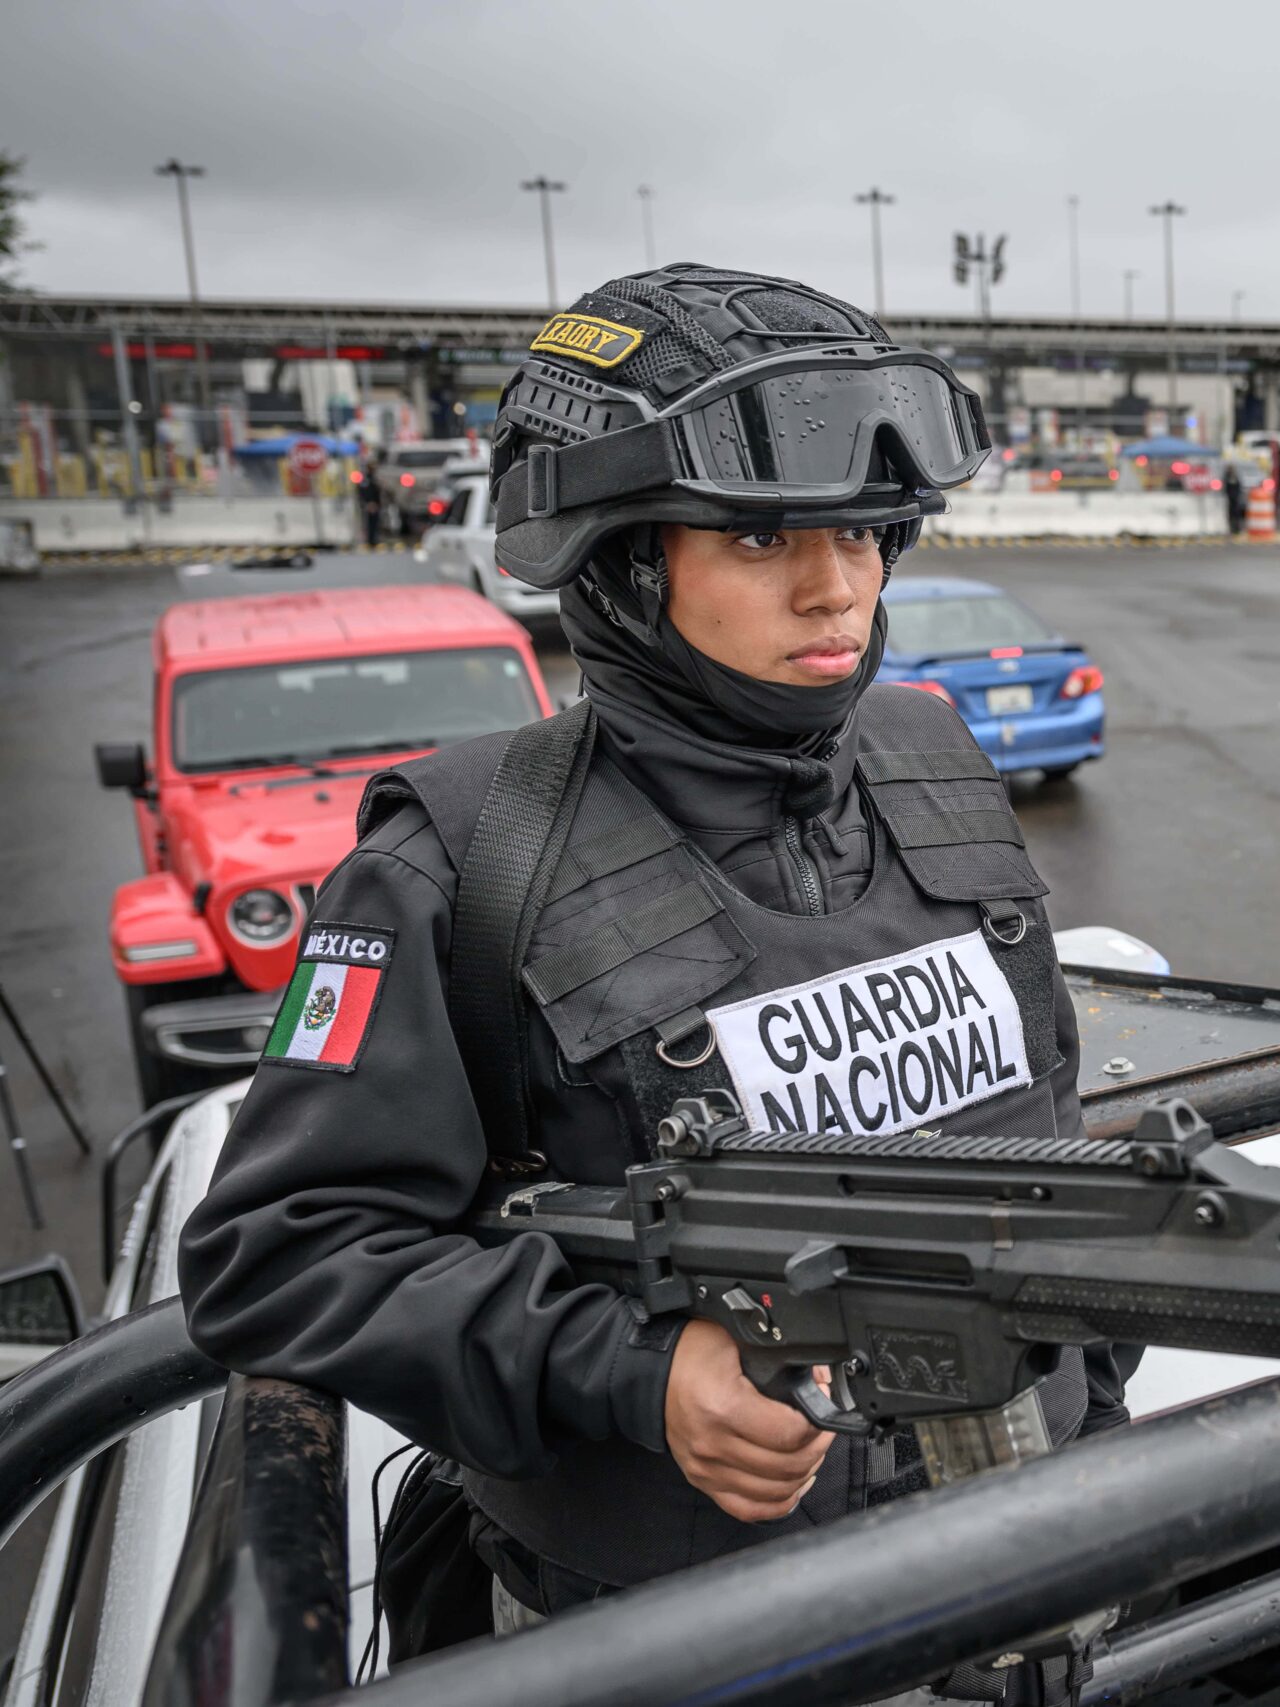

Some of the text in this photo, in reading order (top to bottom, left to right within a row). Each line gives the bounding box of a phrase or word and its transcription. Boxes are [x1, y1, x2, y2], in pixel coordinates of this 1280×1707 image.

[541, 321, 620, 354] KAORY
[304, 930, 387, 961] MÉXICO
[758, 950, 987, 1074] GUARDIA
[760, 1015, 1017, 1135] NACIONAL
[761, 1293, 773, 1309] R
[772, 1326, 782, 1341] S
